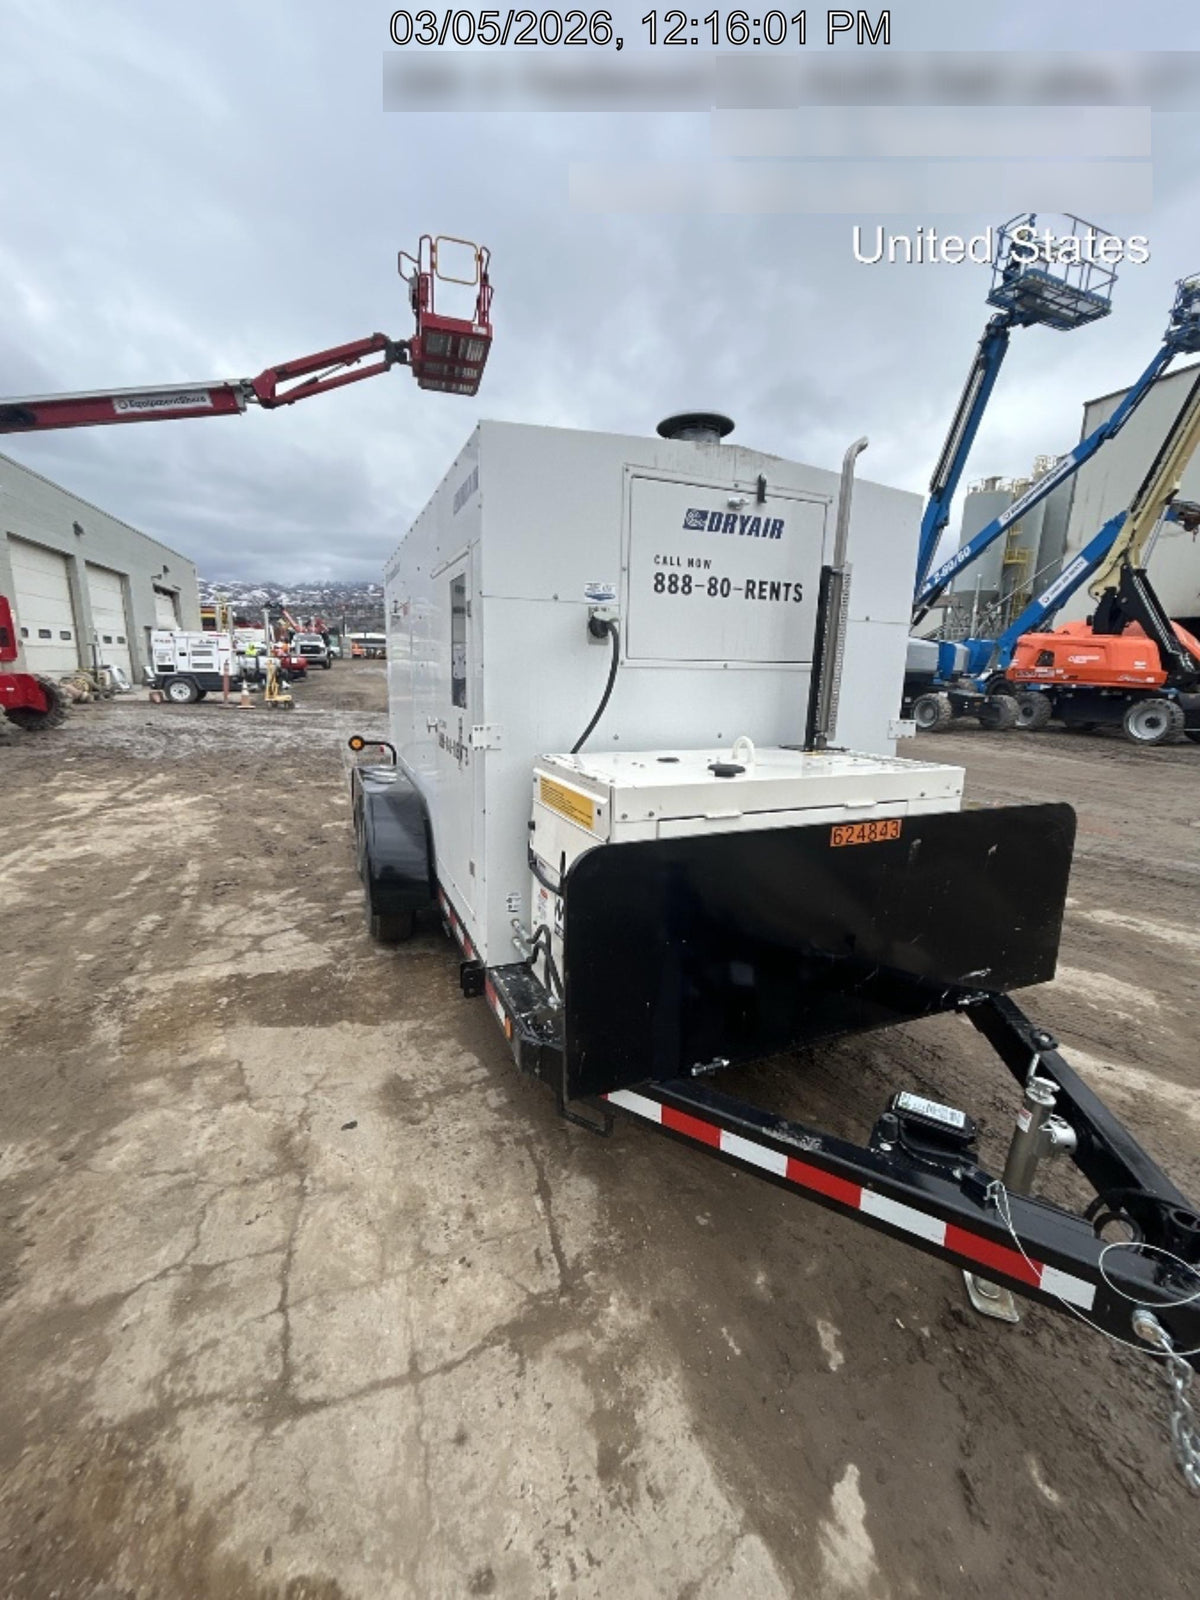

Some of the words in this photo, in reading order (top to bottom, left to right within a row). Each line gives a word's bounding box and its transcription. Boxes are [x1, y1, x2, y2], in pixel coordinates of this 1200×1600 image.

[706, 511, 785, 540] DRYAIR
[653, 554, 682, 567] CALL
[687, 557, 713, 570] NOW
[653, 571, 804, 603] 888-80-RENTS
[833, 820, 899, 846] 624843
